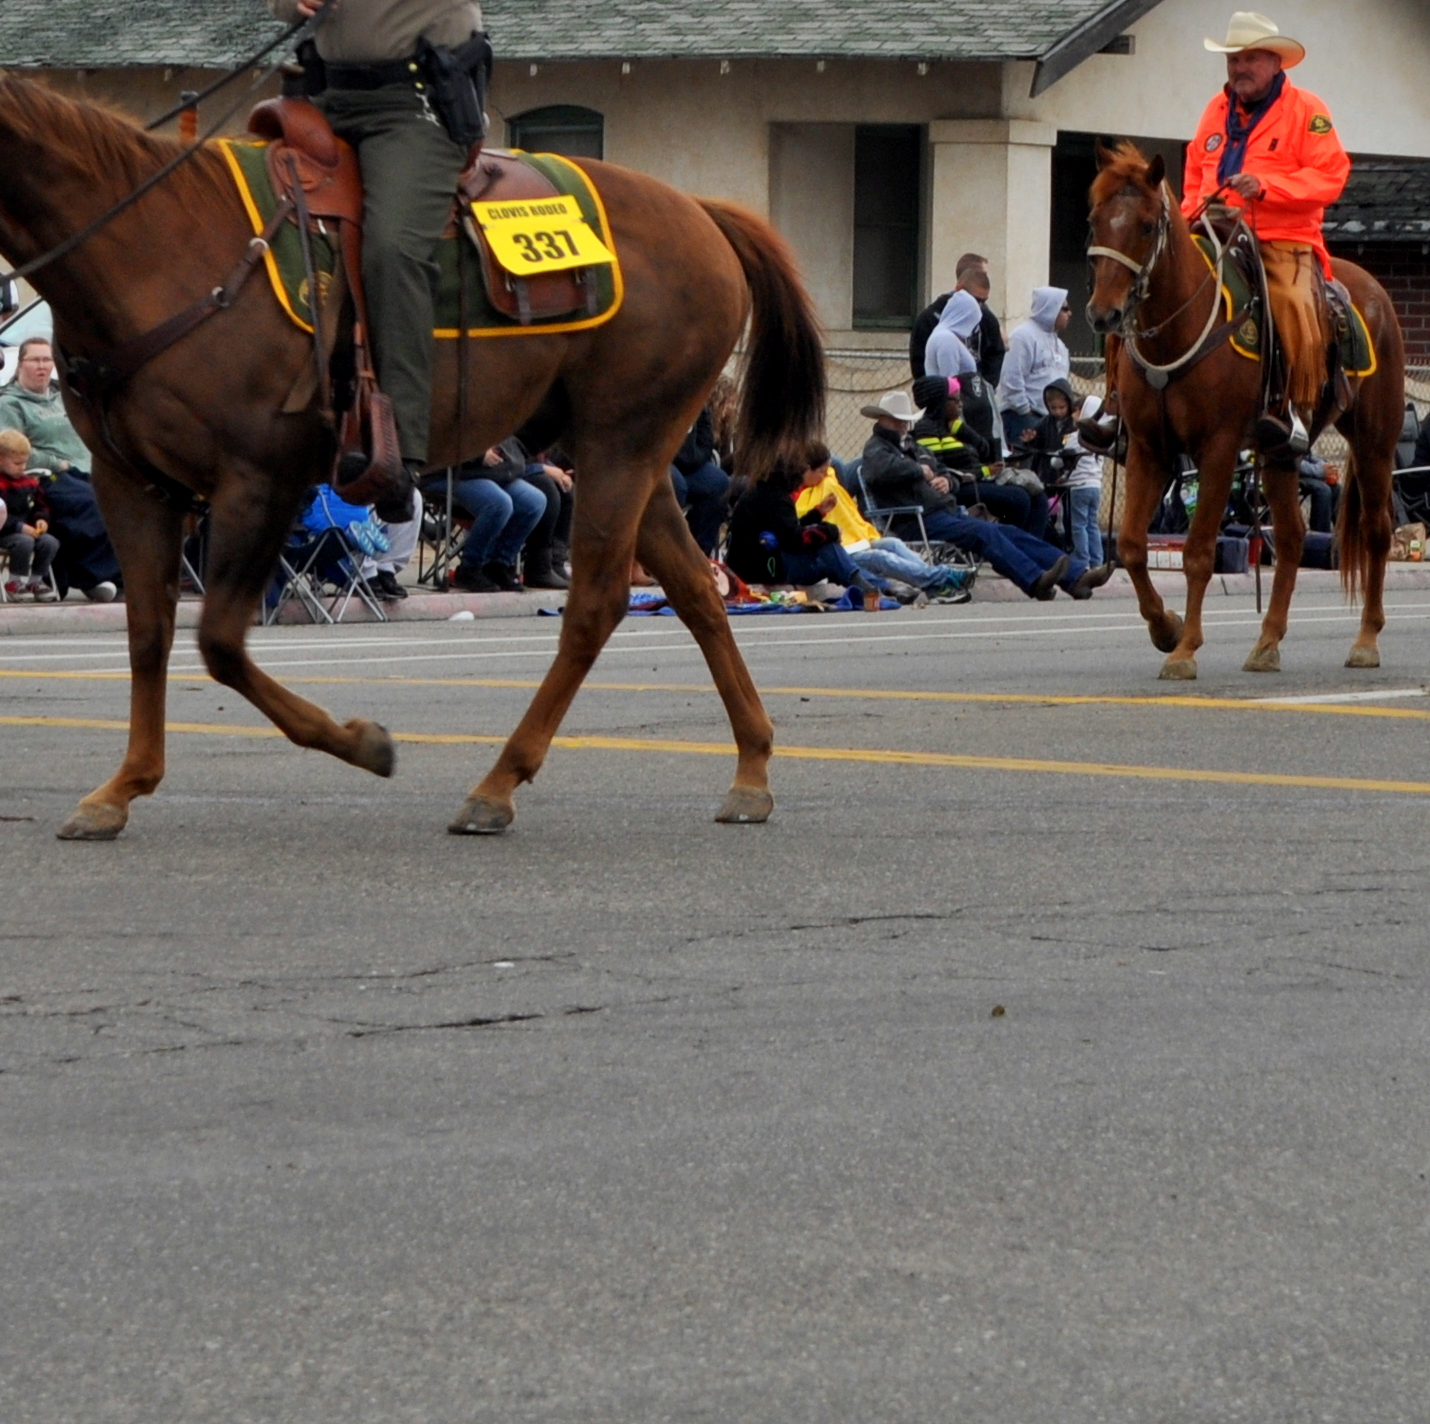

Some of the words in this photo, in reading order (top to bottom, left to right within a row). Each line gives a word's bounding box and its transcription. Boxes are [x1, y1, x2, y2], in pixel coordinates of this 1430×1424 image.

[487, 206, 530, 220] CLOVIS
[529, 203, 568, 217] RODEO
[512, 230, 580, 263] 337
